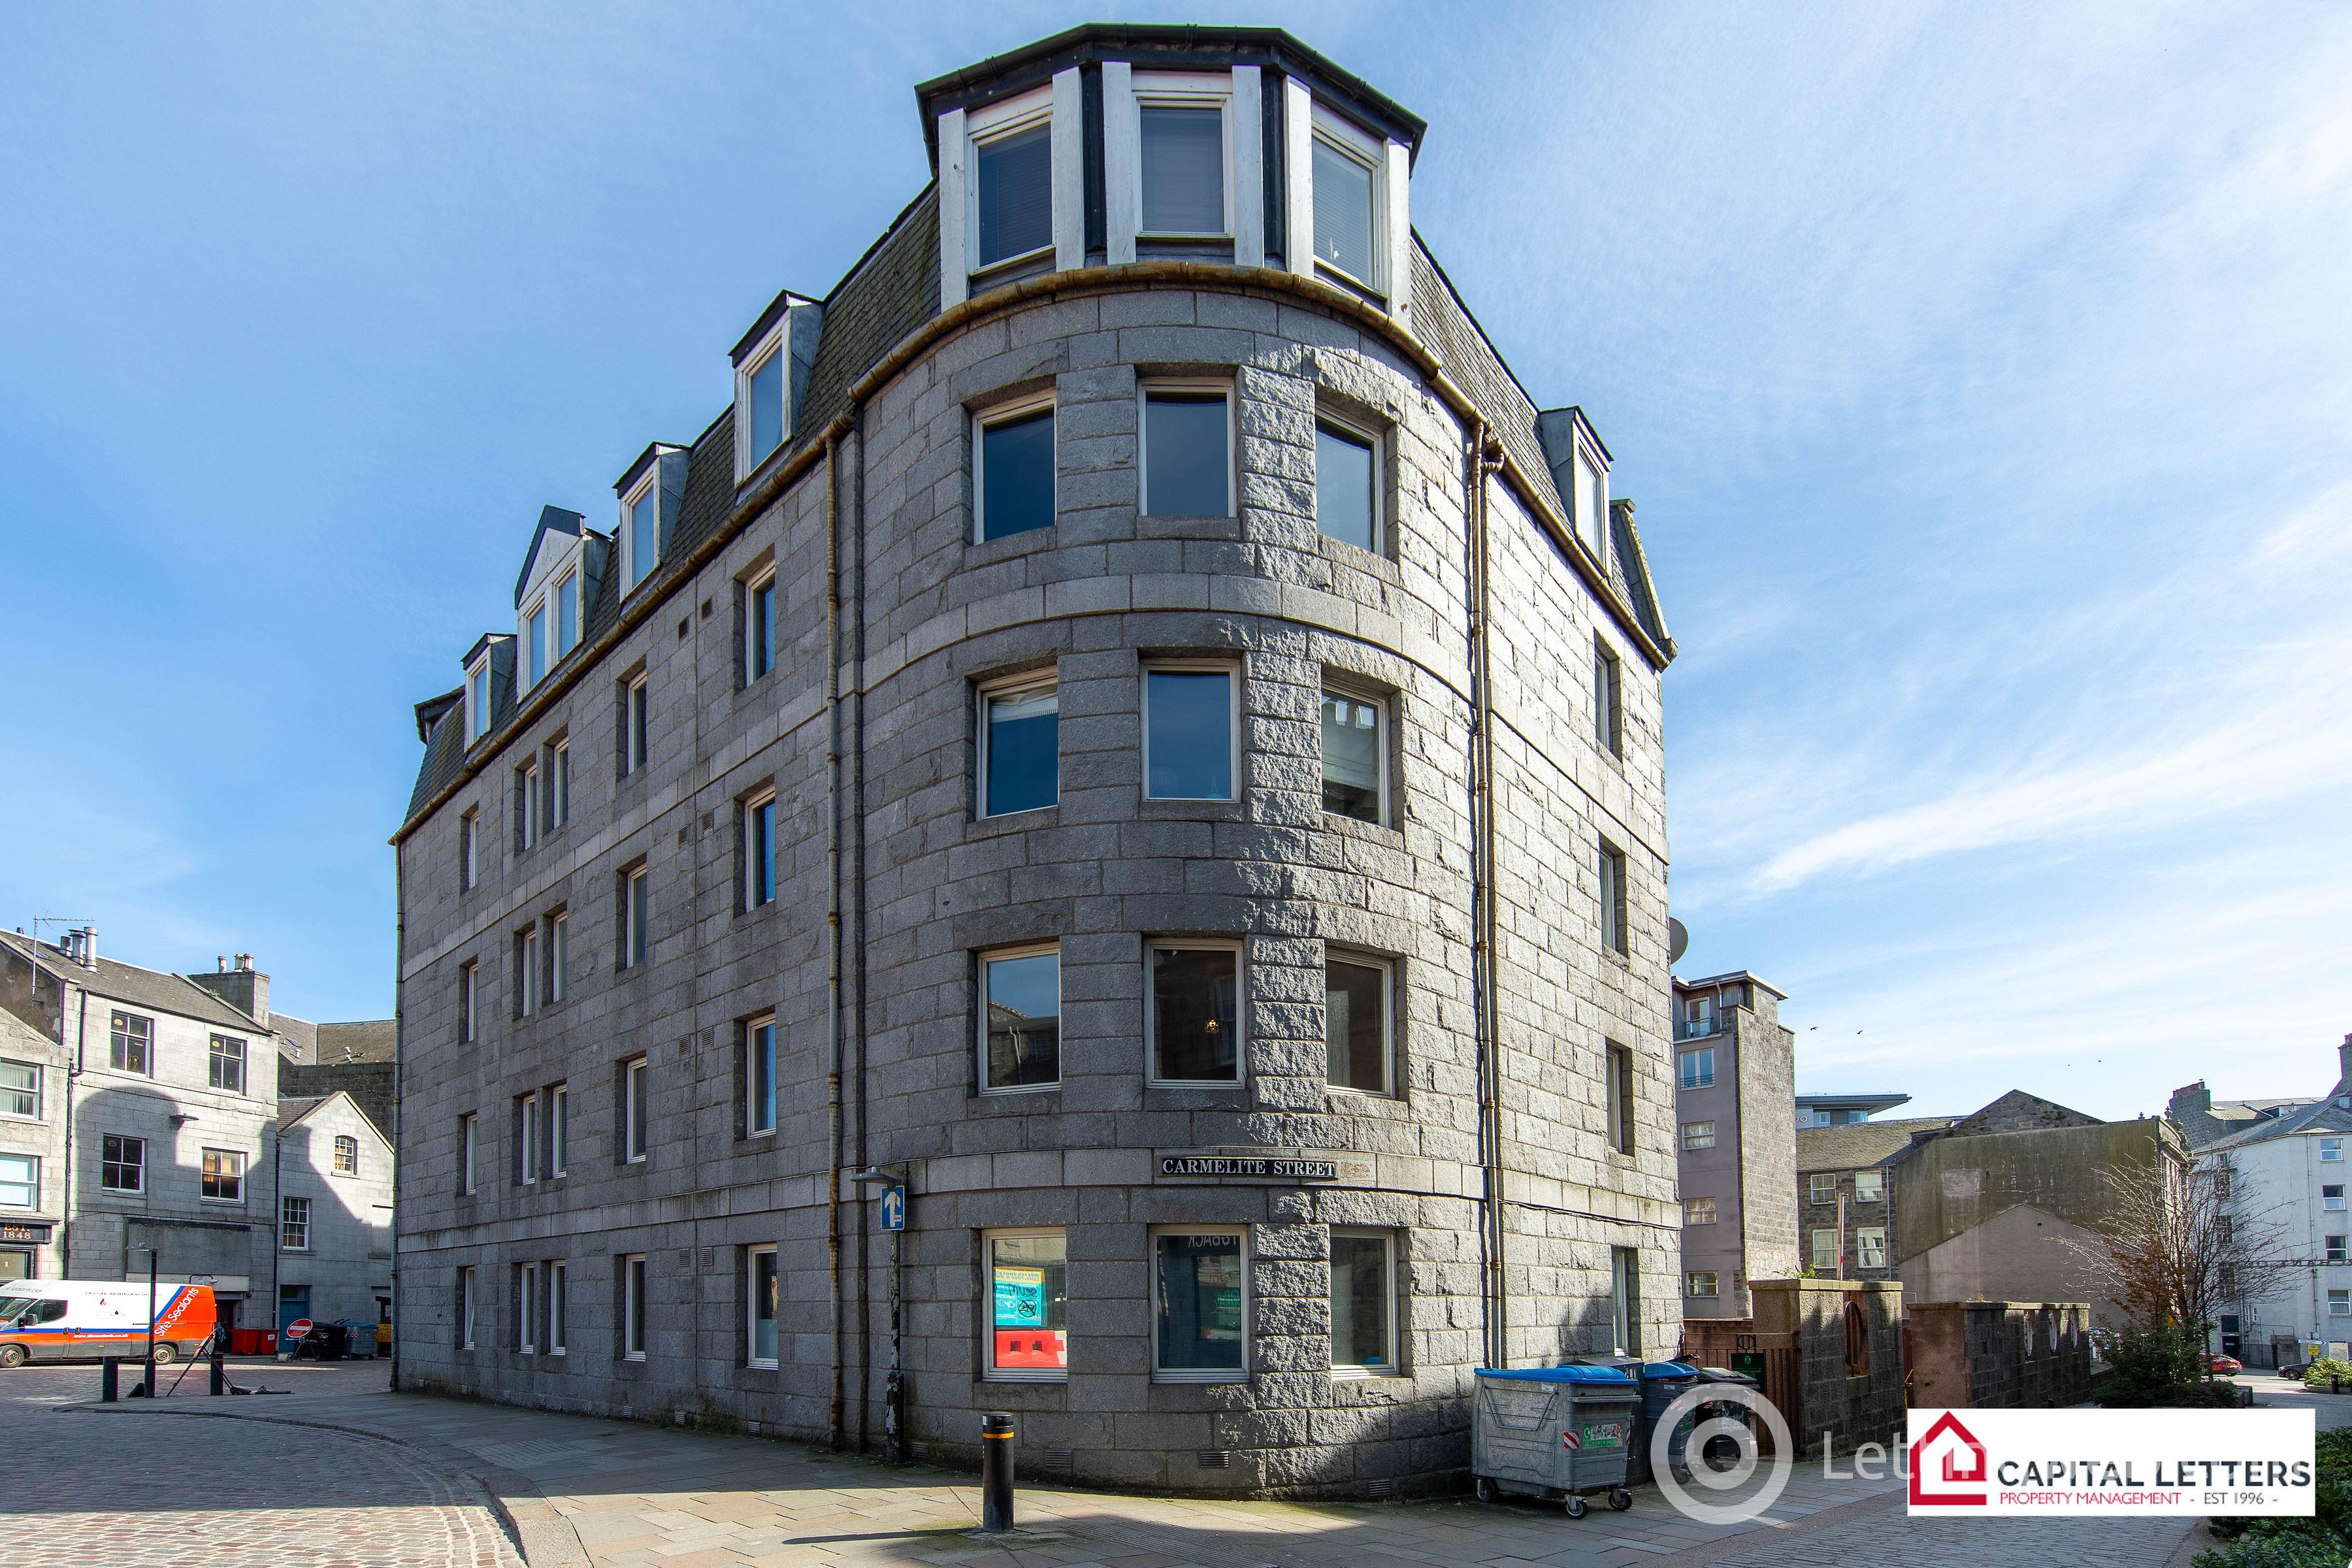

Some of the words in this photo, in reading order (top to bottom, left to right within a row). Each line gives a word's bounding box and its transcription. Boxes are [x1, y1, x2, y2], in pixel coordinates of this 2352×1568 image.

[1162, 1160, 1266, 1174] CARMELITE
[1273, 1161, 1335, 1176] STREET
[154, 1321, 172, 1337] Site
[167, 1288, 199, 1321] Sealants
